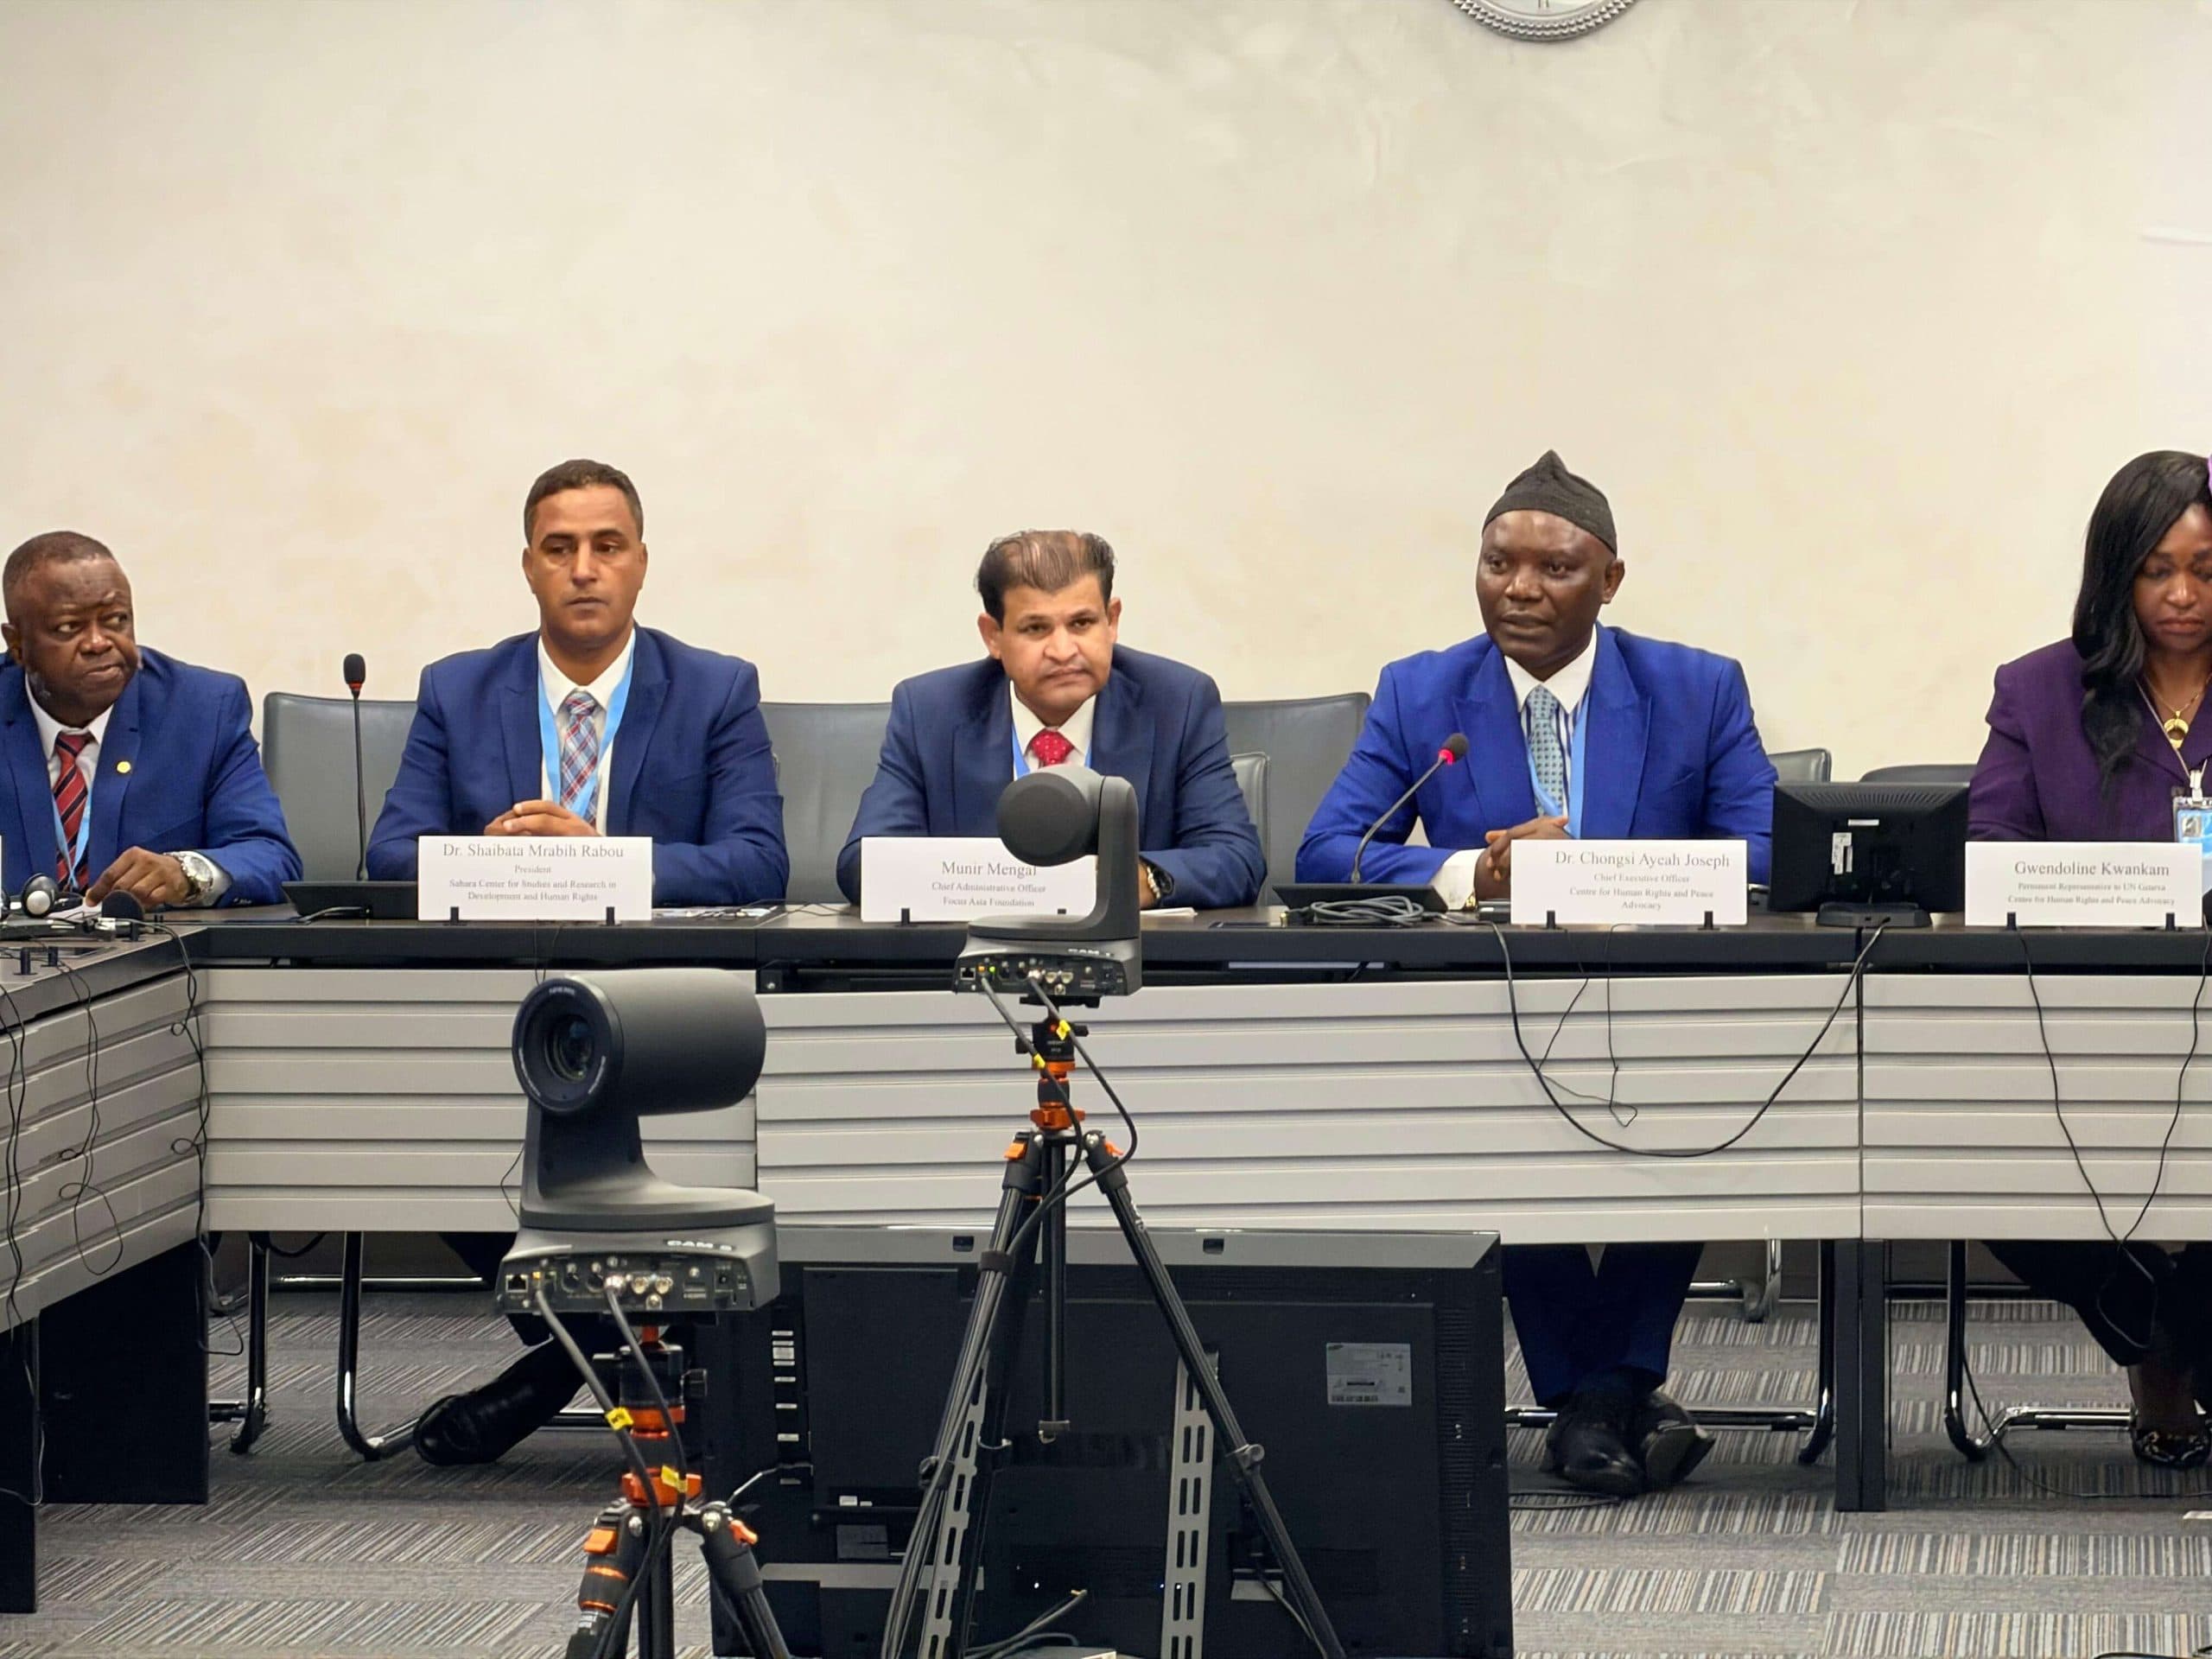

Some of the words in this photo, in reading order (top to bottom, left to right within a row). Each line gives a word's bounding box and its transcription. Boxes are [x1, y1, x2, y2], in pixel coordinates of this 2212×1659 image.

[443, 843, 462, 857] Dr.
[467, 842, 524, 857] Shaibata
[529, 843, 576, 857] Mrabih
[582, 843, 624, 858] Rabou
[1555, 851, 1574, 864] Dr.
[1580, 851, 1635, 868] Chongsi
[1639, 852, 1681, 869] Ayeah
[1685, 853, 1730, 870] Joseph
[514, 865, 551, 874] President
[942, 861, 983, 875] Munir
[987, 861, 1037, 880] Mengal
[2014, 861, 2096, 875] Gwendoline
[2101, 861, 2170, 876] Kwankam
[1594, 873, 1617, 881] Chief
[507, 879, 518, 888] for
[552, 880, 568, 888] and
[524, 892, 537, 900] and
[540, 892, 569, 900] Human
[572, 892, 598, 902] Rights
